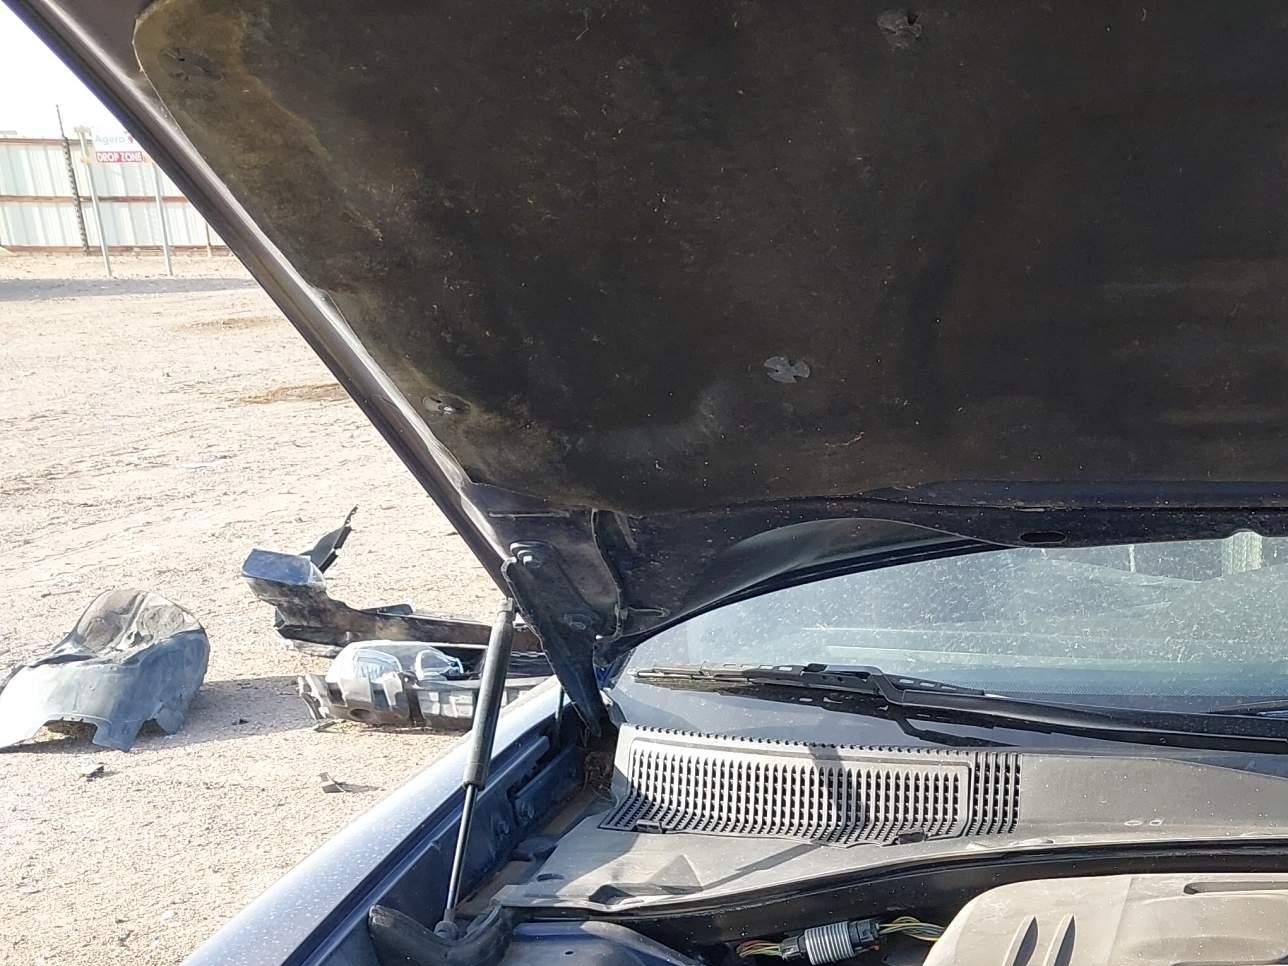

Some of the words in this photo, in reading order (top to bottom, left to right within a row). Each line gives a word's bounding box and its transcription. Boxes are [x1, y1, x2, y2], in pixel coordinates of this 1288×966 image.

[95, 135, 126, 145] Agero
[97, 152, 119, 162] DROP
[120, 152, 142, 162] ZONE
